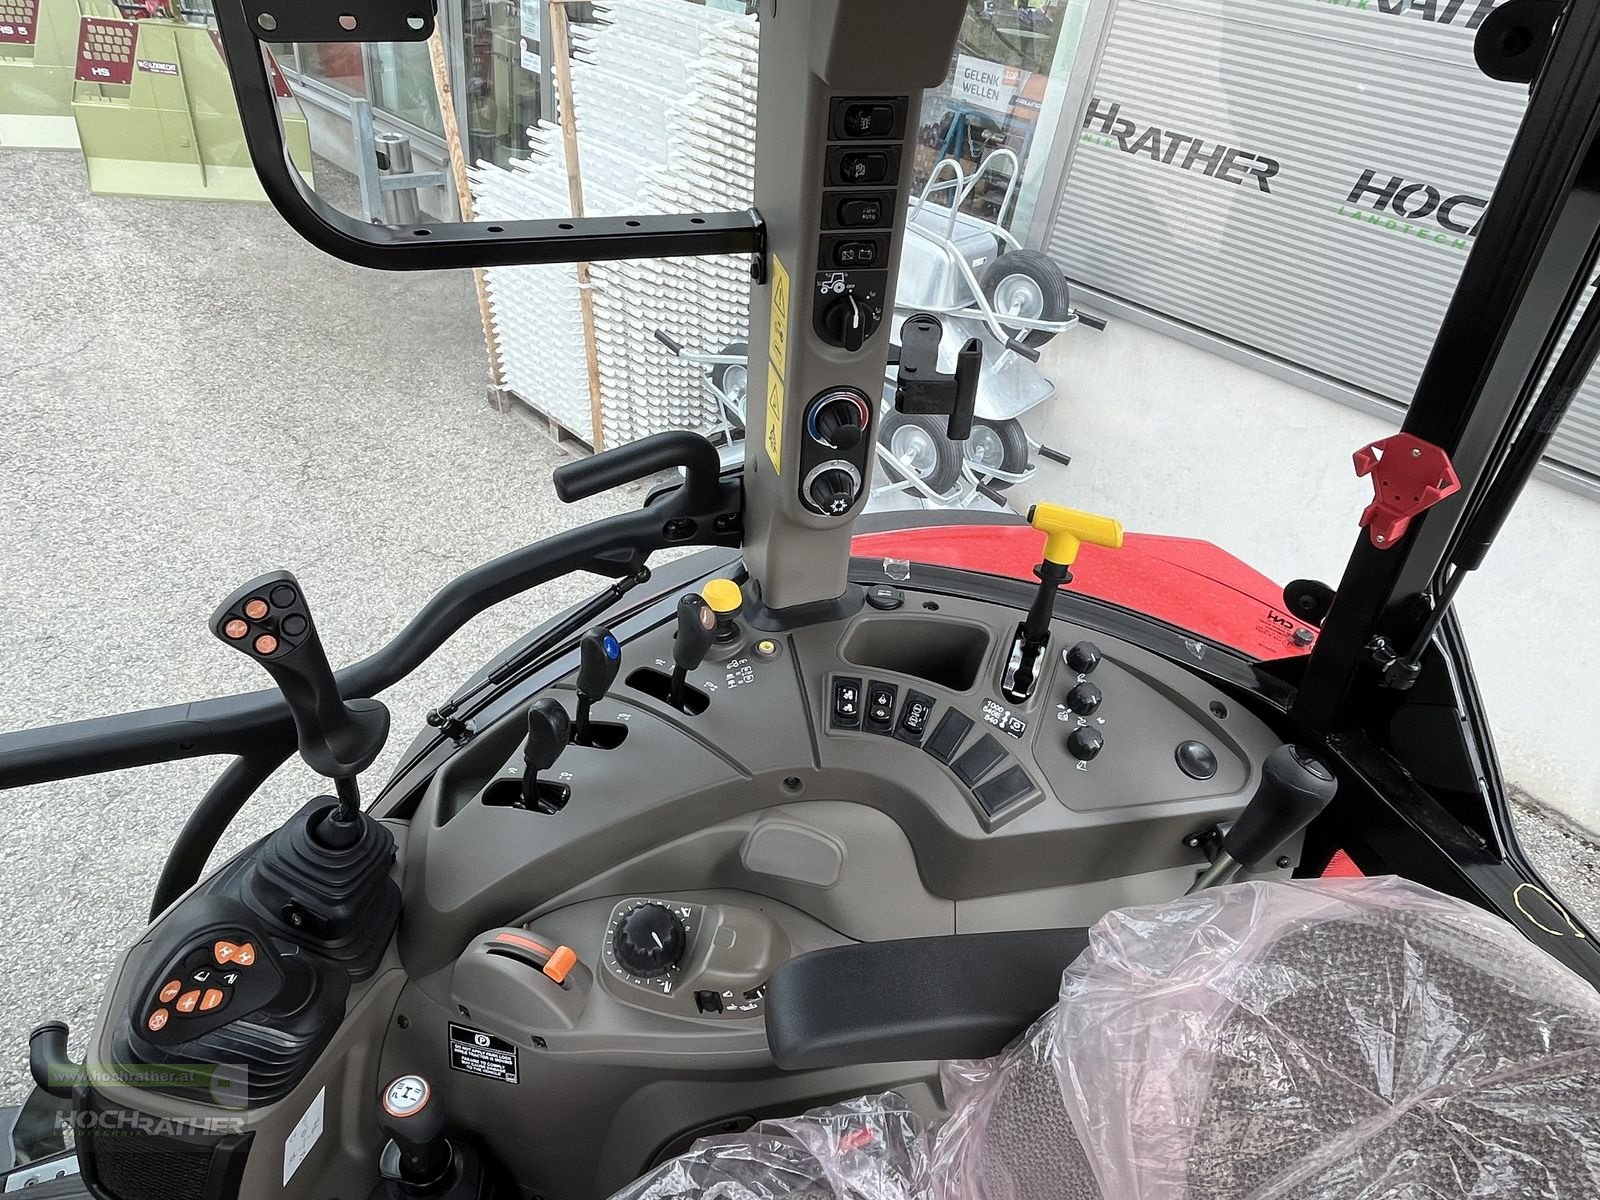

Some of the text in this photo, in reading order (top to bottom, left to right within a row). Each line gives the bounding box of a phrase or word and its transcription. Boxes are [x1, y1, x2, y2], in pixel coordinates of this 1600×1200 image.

[17, 27, 28, 35] 5
[92, 67, 110, 77] HS
[964, 68, 1000, 87] GELENK
[963, 82, 1000, 101] WELLEN
[1346, 168, 1487, 237] HOC
[1337, 206, 1468, 250] LANDTECH
[987, 700, 1004, 713] 1000
